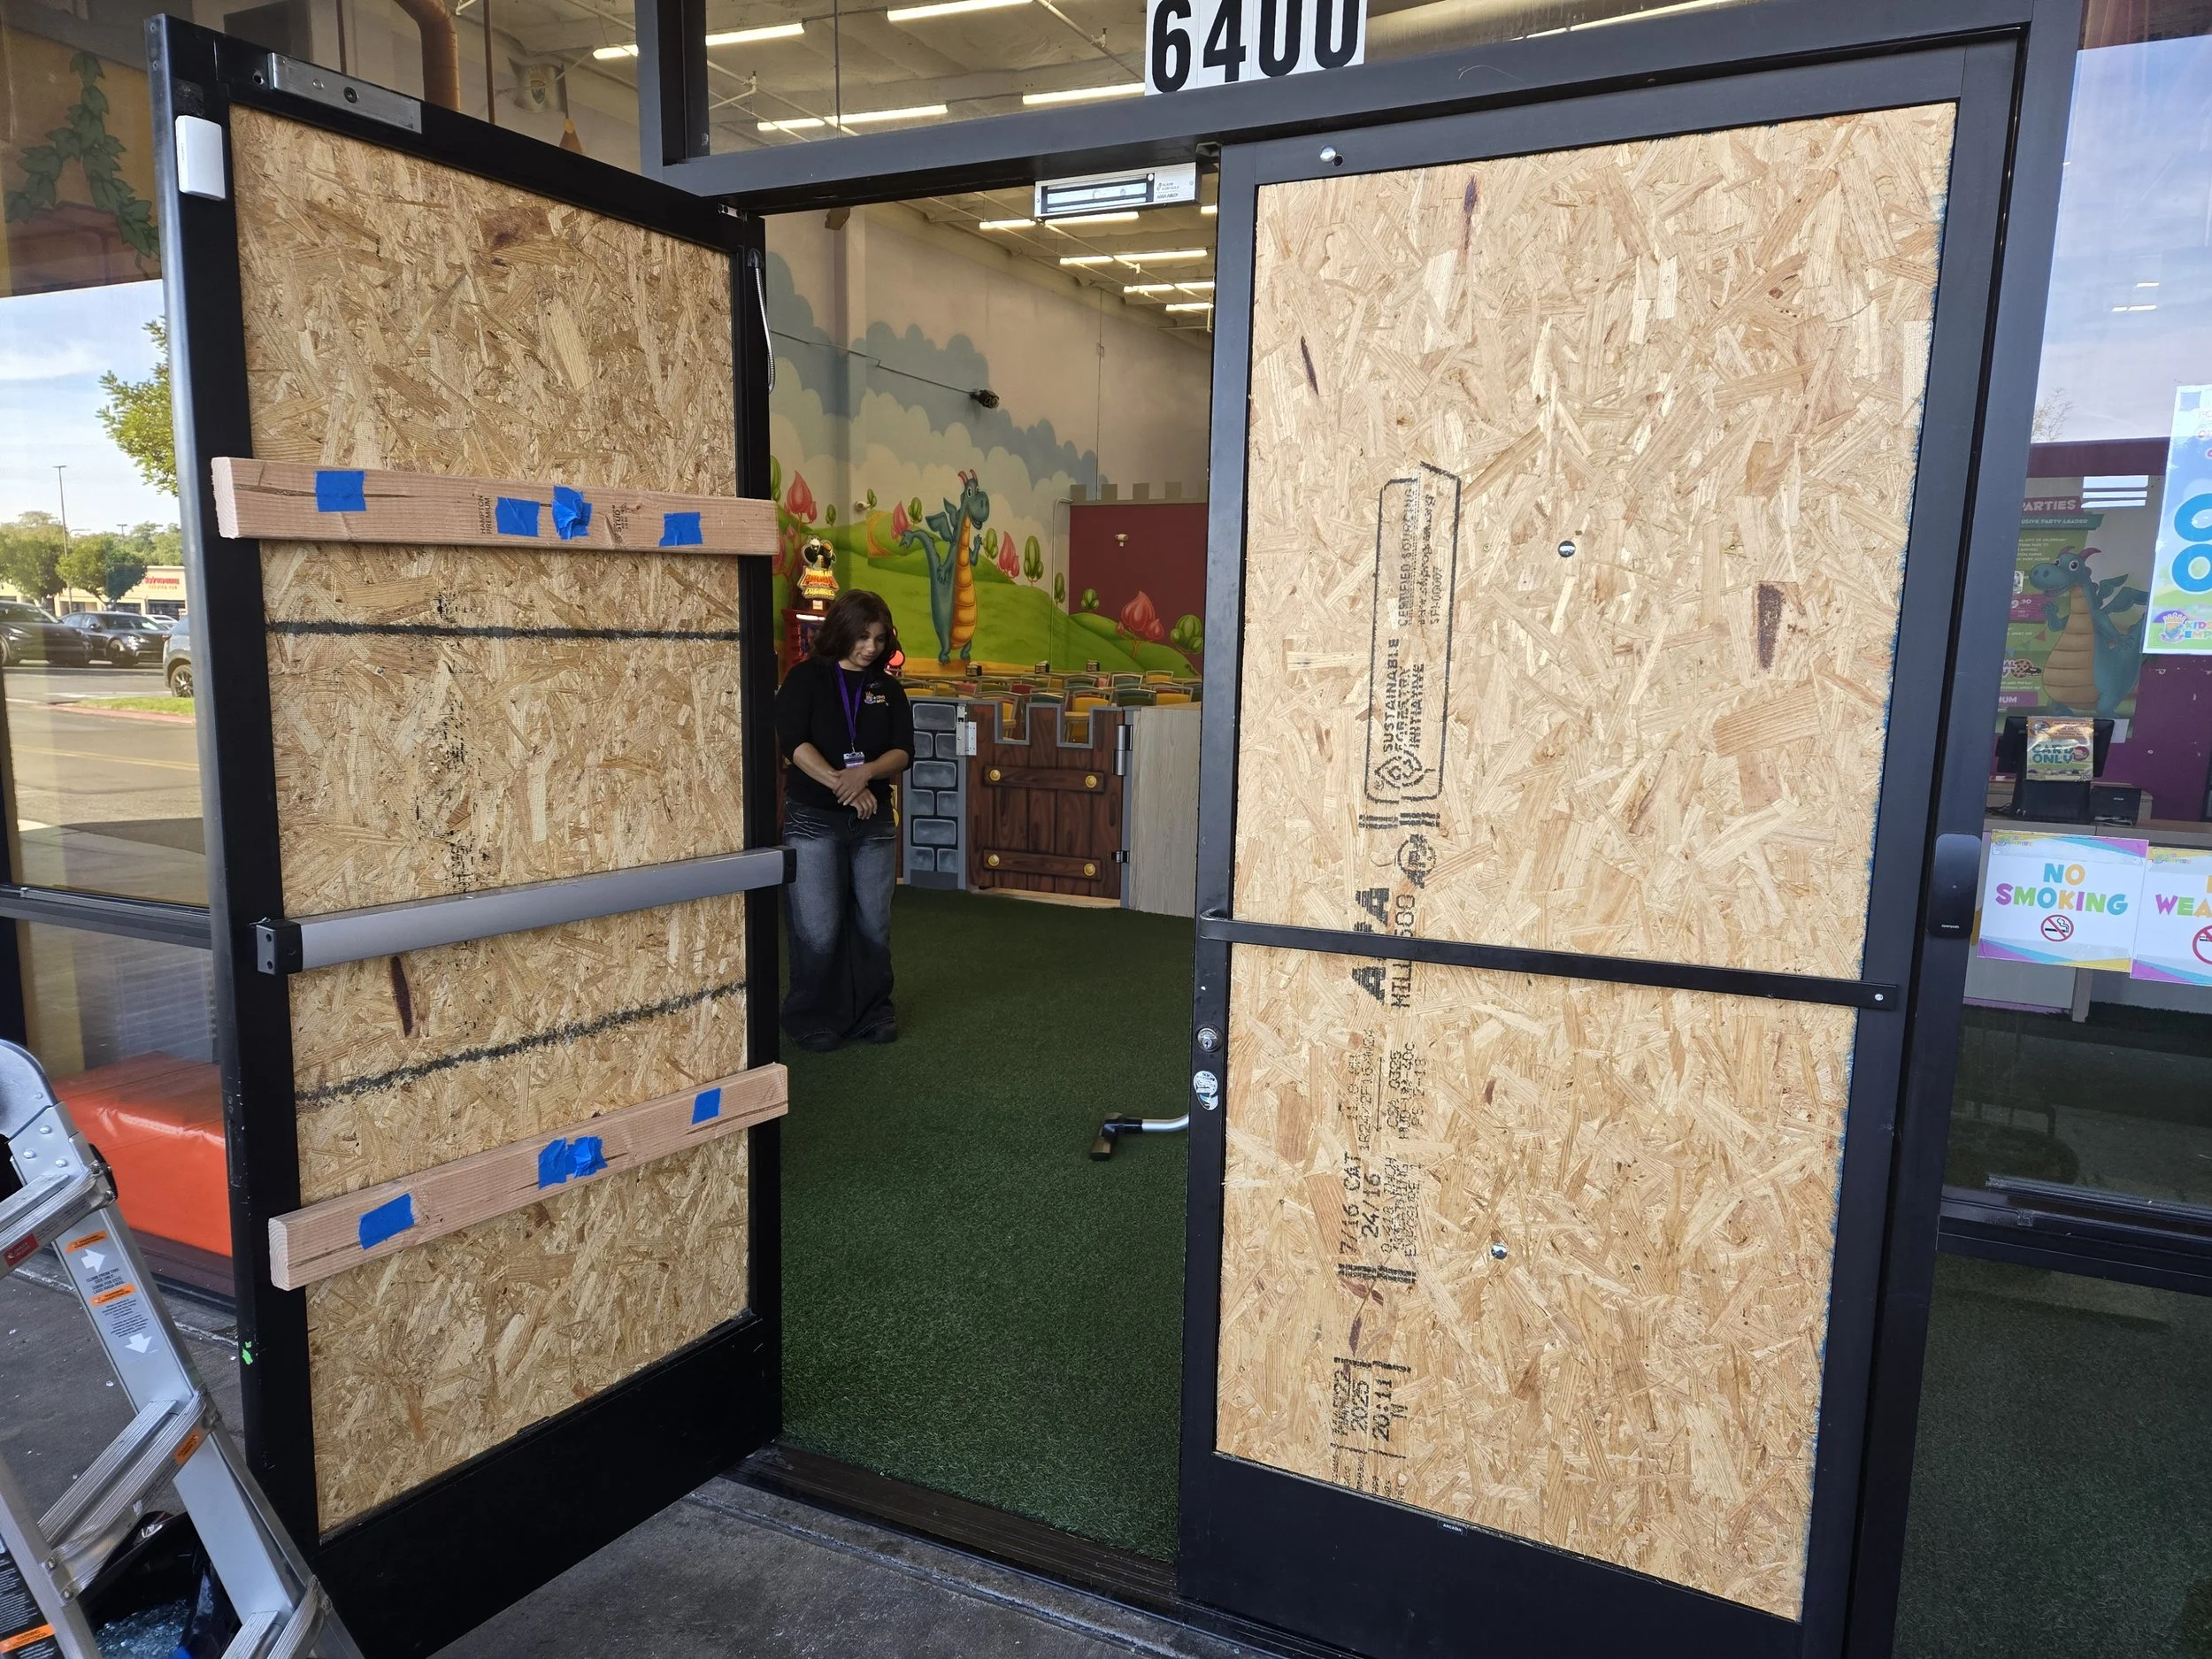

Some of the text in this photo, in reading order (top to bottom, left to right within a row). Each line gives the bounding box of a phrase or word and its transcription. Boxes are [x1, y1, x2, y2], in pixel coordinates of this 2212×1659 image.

[1151, 0, 1360, 93] 6400
[2023, 500, 2076, 511] ARTIES
[1398, 564, 1410, 626] CERTIFIED
[2185, 630, 2212, 639] EMP
[1383, 638, 1399, 752] SUSTAINABLE
[1394, 666, 1410, 751] FORESTRY
[1409, 663, 1425, 749] INITIATIVE
[2032, 753, 2073, 764] ONLY
[1995, 883, 2129, 916] SMOKING
[2043, 863, 2085, 886] NO
[2155, 894, 2212, 918] WEA
[1390, 959, 1412, 1009] MILL
[1340, 1151, 1361, 1255] 7/16 CAT
[1360, 1173, 1380, 1239] 24/16
[1350, 1379, 1369, 1434] 2025
[1371, 1379, 1392, 1442] 20:11
